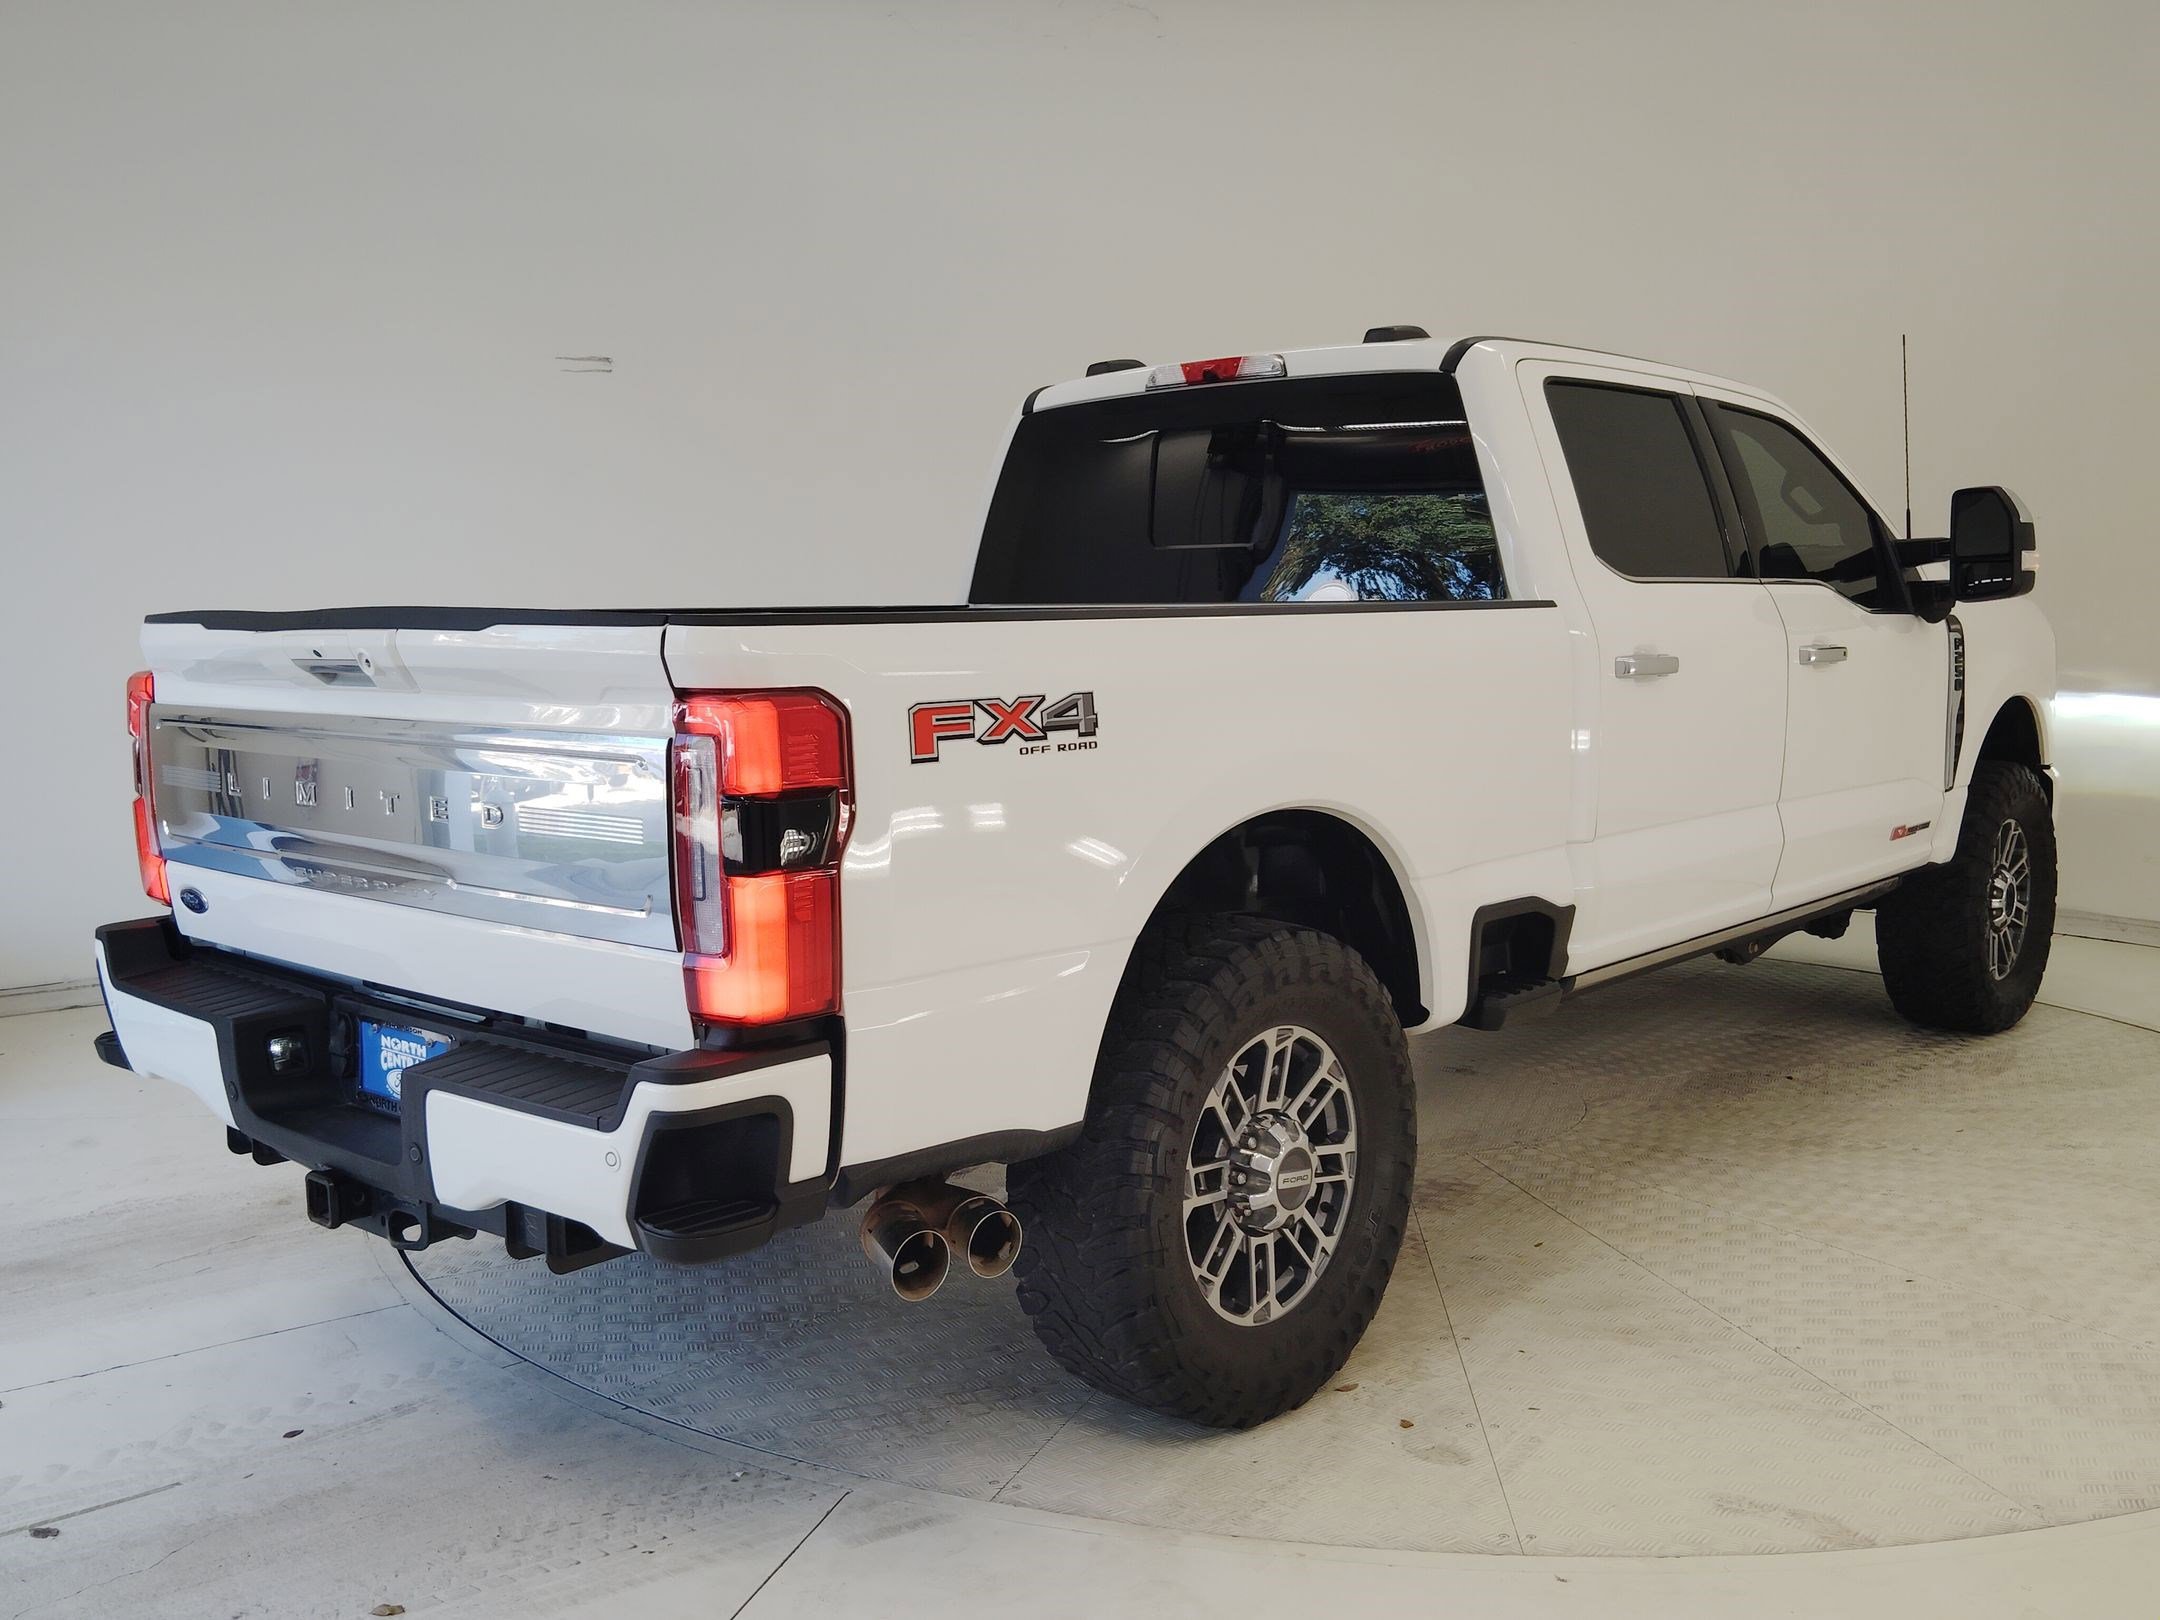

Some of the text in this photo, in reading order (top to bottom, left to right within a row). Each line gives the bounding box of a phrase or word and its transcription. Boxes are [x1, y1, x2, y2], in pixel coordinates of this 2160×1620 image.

[908, 691, 1098, 764] FX4
[1019, 740, 1098, 756] OFF ROAD
[227, 770, 504, 830] LIMITED
[381, 1034, 427, 1058] NORTH
[381, 1049, 423, 1071] CENTR
[1282, 1174, 1309, 1185] FORD
